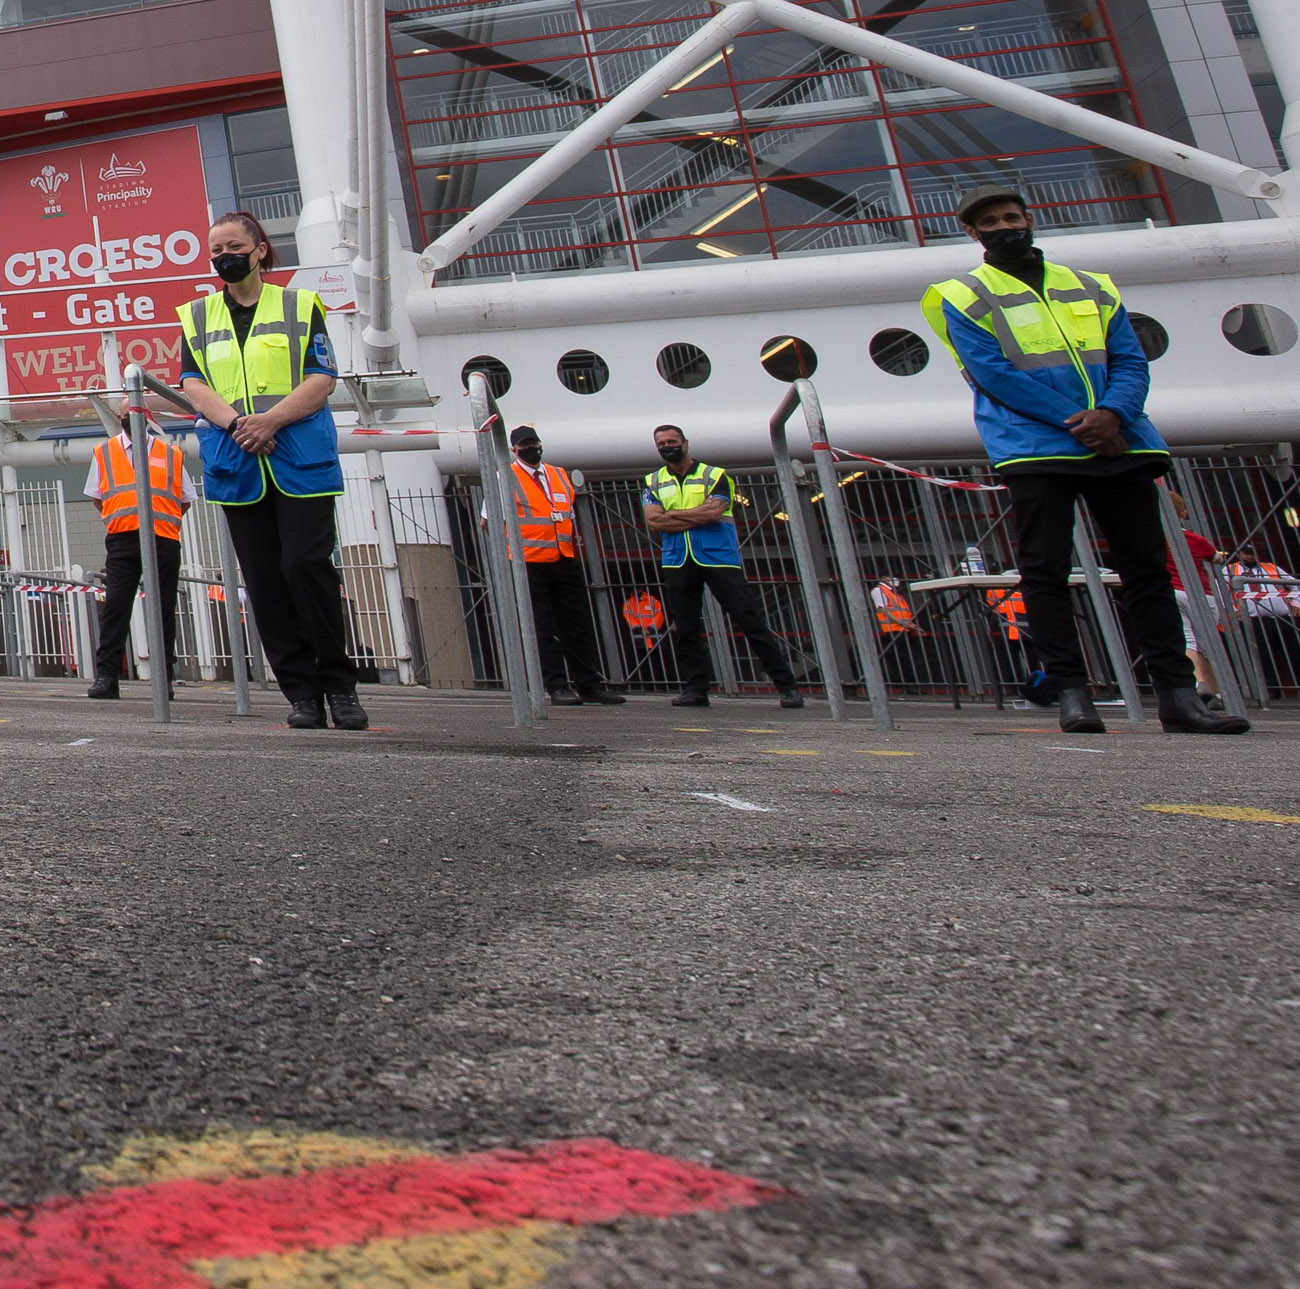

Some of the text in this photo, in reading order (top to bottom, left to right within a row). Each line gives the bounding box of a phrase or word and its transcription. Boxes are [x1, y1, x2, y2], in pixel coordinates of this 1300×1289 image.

[96, 186, 153, 202] Principality
[44, 205, 62, 214] WRU
[4, 229, 200, 286] CROESO
[66, 292, 155, 327] Gate
